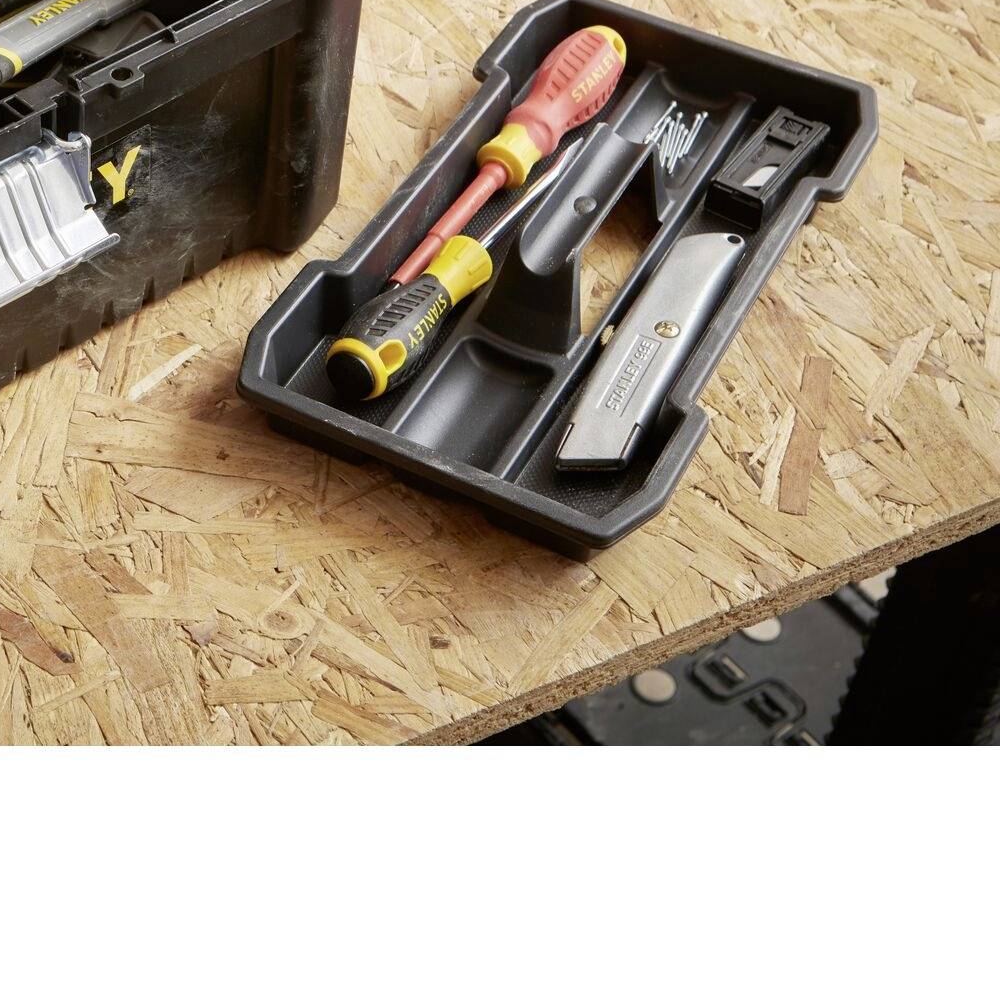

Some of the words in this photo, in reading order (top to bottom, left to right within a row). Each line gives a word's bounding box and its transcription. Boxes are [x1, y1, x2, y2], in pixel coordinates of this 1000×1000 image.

[571, 50, 616, 104] STANLEY
[408, 293, 447, 349] STANLEY
[605, 360, 642, 412] STANLEY
